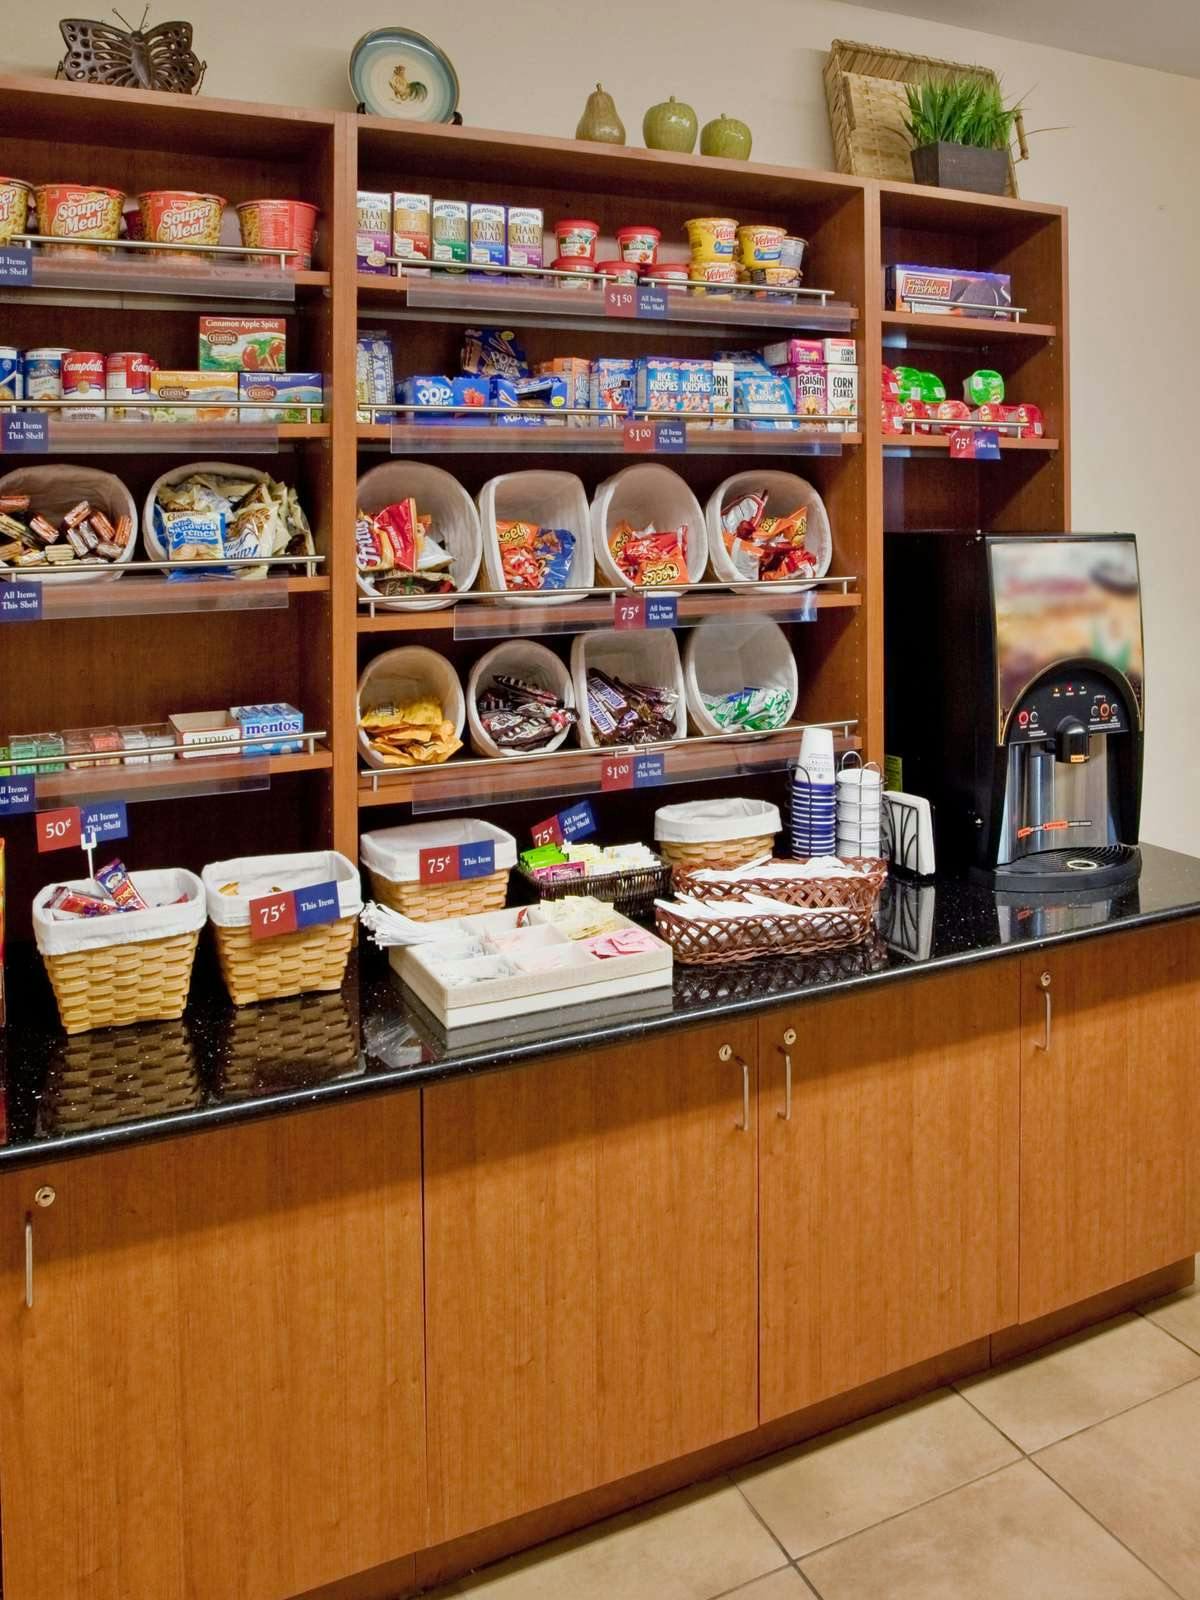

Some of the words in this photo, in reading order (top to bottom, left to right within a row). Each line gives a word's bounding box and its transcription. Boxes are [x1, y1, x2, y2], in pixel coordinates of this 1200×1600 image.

[58, 197, 108, 220] Souper
[162, 205, 211, 227] Souper
[361, 210, 383, 219] HAM
[64, 211, 102, 235] Meal
[476, 222, 499, 231] TUNA
[168, 222, 206, 241] Meal
[516, 225, 536, 234] HAM
[512, 236, 539, 244] SALAD
[7, 256, 26, 265] Items
[9, 267, 28, 276] Shelf
[652, 303, 665, 311] Shelf
[206, 319, 240, 328] Cinnamon
[240, 321, 260, 329] Apple
[657, 372, 671, 381] RICE
[689, 373, 704, 381] RICE
[713, 375, 728, 386] ORN
[800, 373, 825, 387] Raisin
[650, 381, 678, 391] KRISPIES
[682, 382, 711, 392] KRISPIES
[833, 377, 853, 388] CORN
[713, 387, 728, 396] AKES
[802, 386, 822, 396] Bran
[833, 389, 853, 398] FLAKES
[9, 421, 20, 429] All
[23, 421, 42, 429] Items
[8, 432, 24, 440] This
[26, 431, 44, 440] Shelf
[955, 439, 970, 449] 75¢
[167, 521, 217, 535] Sandwich
[174, 529, 216, 541] Cremes
[356, 520, 380, 570] Fritos
[3, 591, 15, 599] All
[17, 590, 37, 598] Items
[2, 601, 18, 609] This
[20, 600, 38, 609] Shelf
[621, 606, 639, 620] 75¢
[246, 720, 300, 735] mentos
[637, 770, 648, 778] This
[649, 769, 662, 777] Shelf
[8, 785, 27, 793] Items
[11, 794, 30, 803] Shelf
[87, 813, 98, 822] All
[100, 812, 119, 821] Items
[564, 817, 573, 827] All
[573, 812, 587, 821] Items
[45, 818, 72, 839] 50¢
[85, 823, 102, 834] This
[103, 820, 121, 831] Shelf
[564, 825, 577, 835] This
[577, 817, 590, 829] Shelf
[535, 826, 553, 846] 75¢
[428, 854, 452, 874] 75¢
[463, 857, 477, 866] This
[478, 855, 491, 863] Item
[301, 902, 317, 911] This
[318, 898, 335, 907] Item
[260, 901, 287, 925] 75¢
